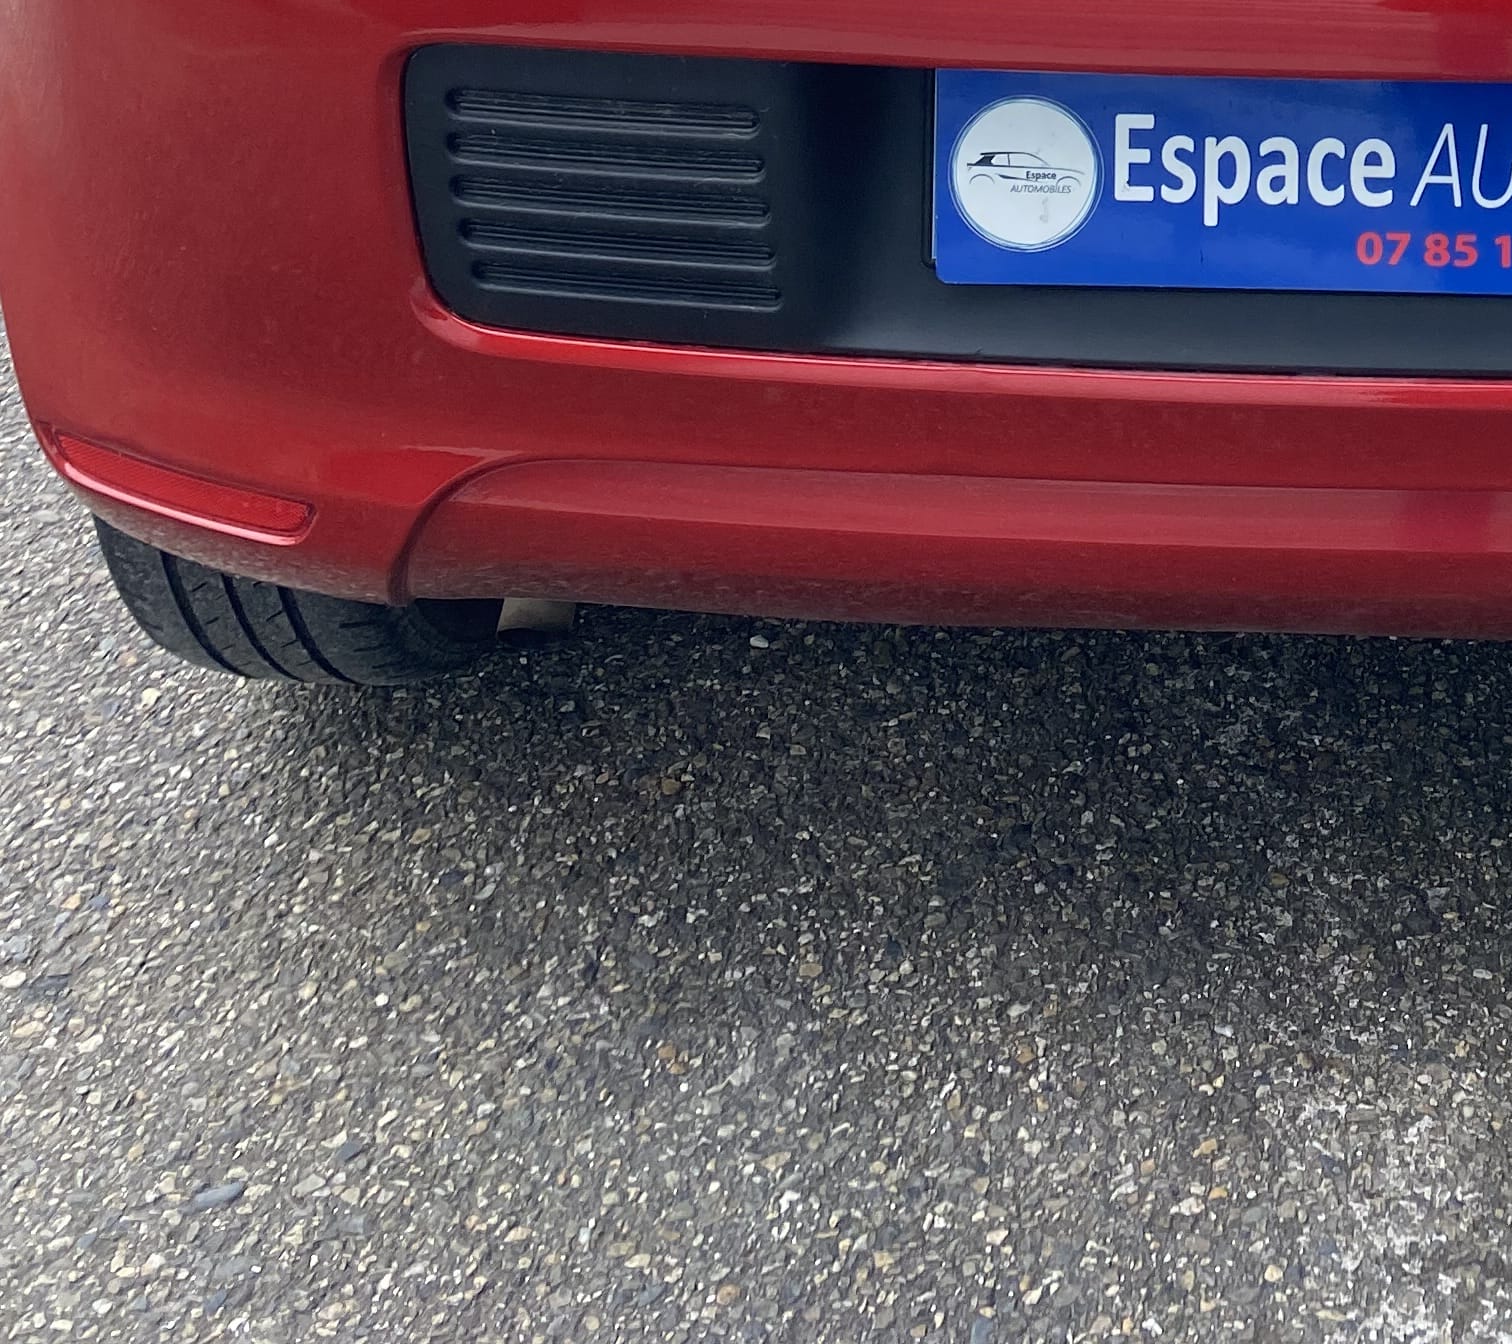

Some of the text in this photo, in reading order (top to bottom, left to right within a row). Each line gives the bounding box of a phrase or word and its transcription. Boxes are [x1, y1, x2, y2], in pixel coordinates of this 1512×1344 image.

[1026, 171, 1057, 181] Espace
[1114, 113, 1396, 227] Espace
[1010, 185, 1072, 194] AUTOMOBILES
[1356, 232, 1411, 266] 07
[1423, 233, 1478, 268] 85
